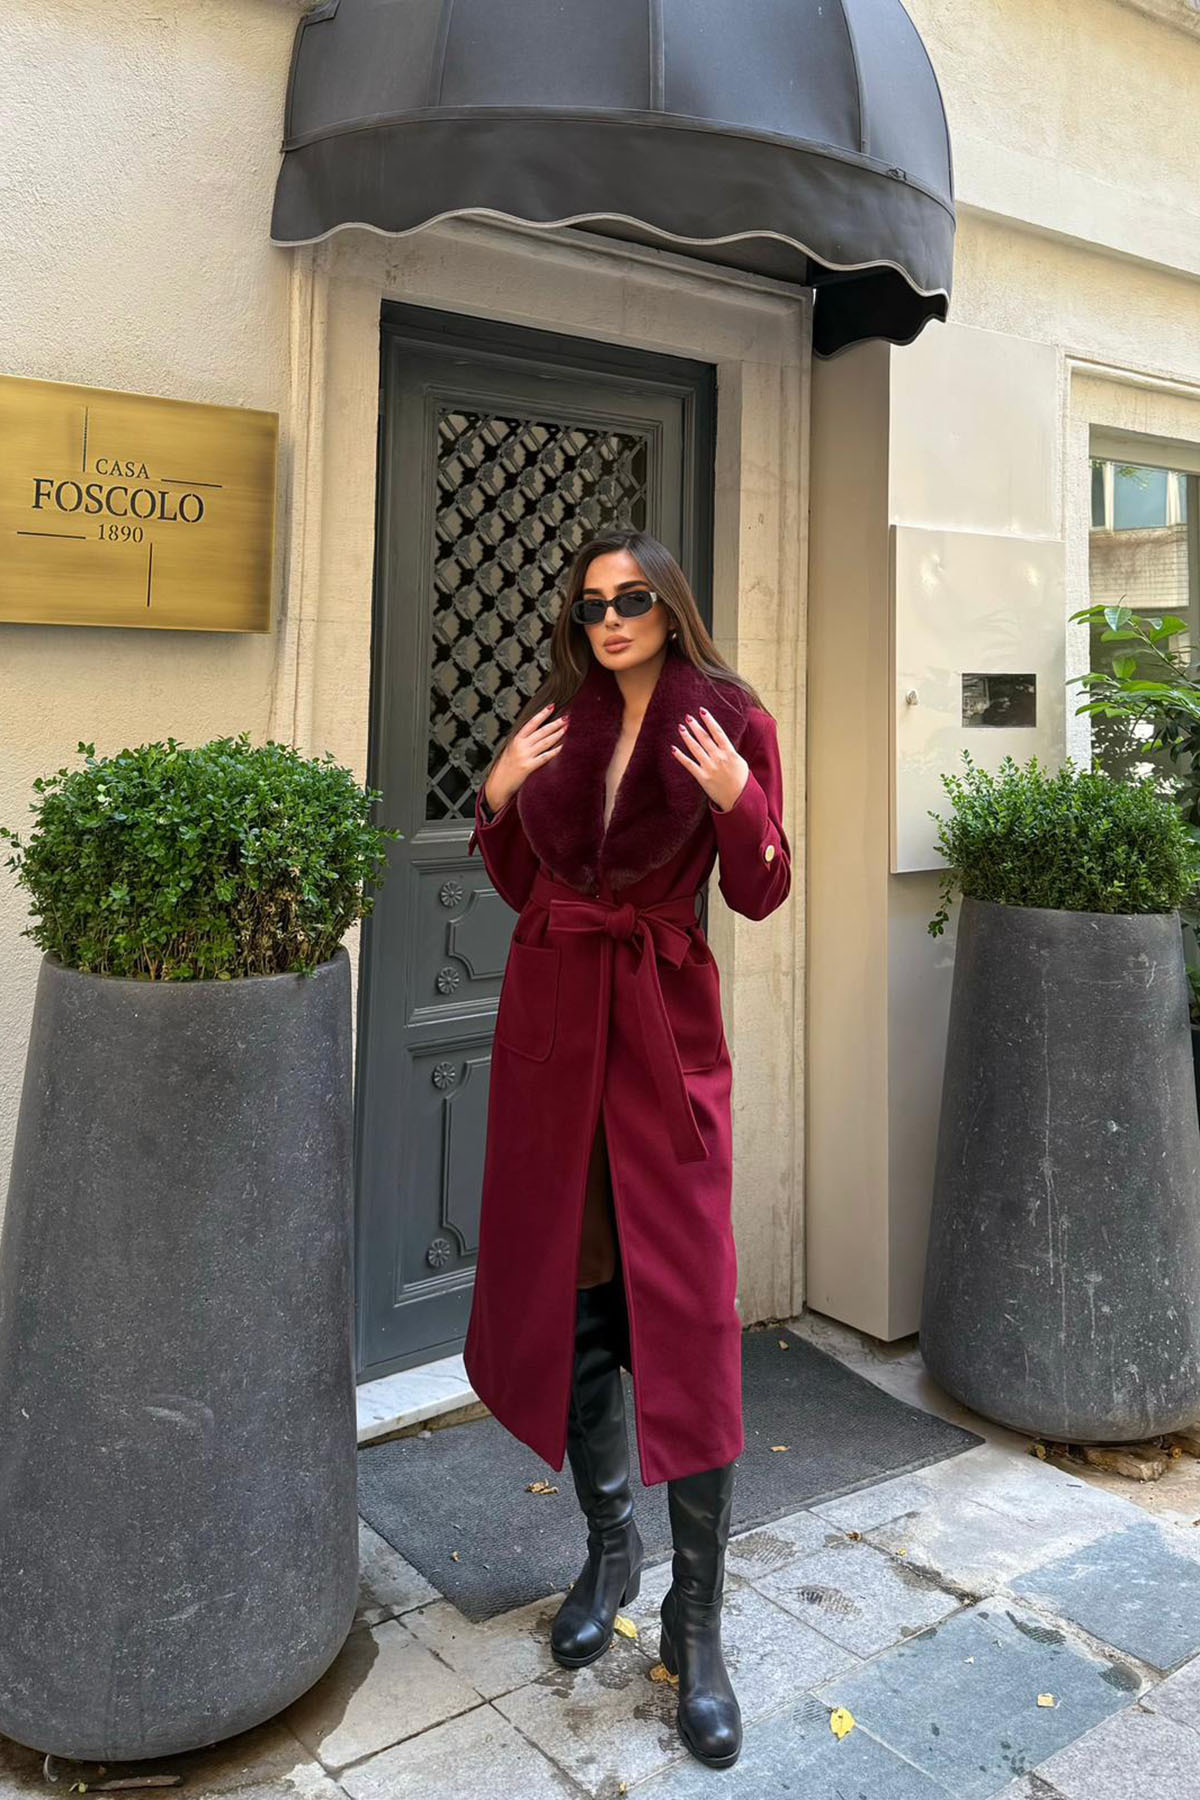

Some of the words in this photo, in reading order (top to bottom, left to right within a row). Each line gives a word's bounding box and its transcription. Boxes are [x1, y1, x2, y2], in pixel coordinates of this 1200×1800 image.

[95, 458, 150, 480] CASA
[31, 478, 205, 523] FOSCOLO
[97, 523, 144, 544] 1890
